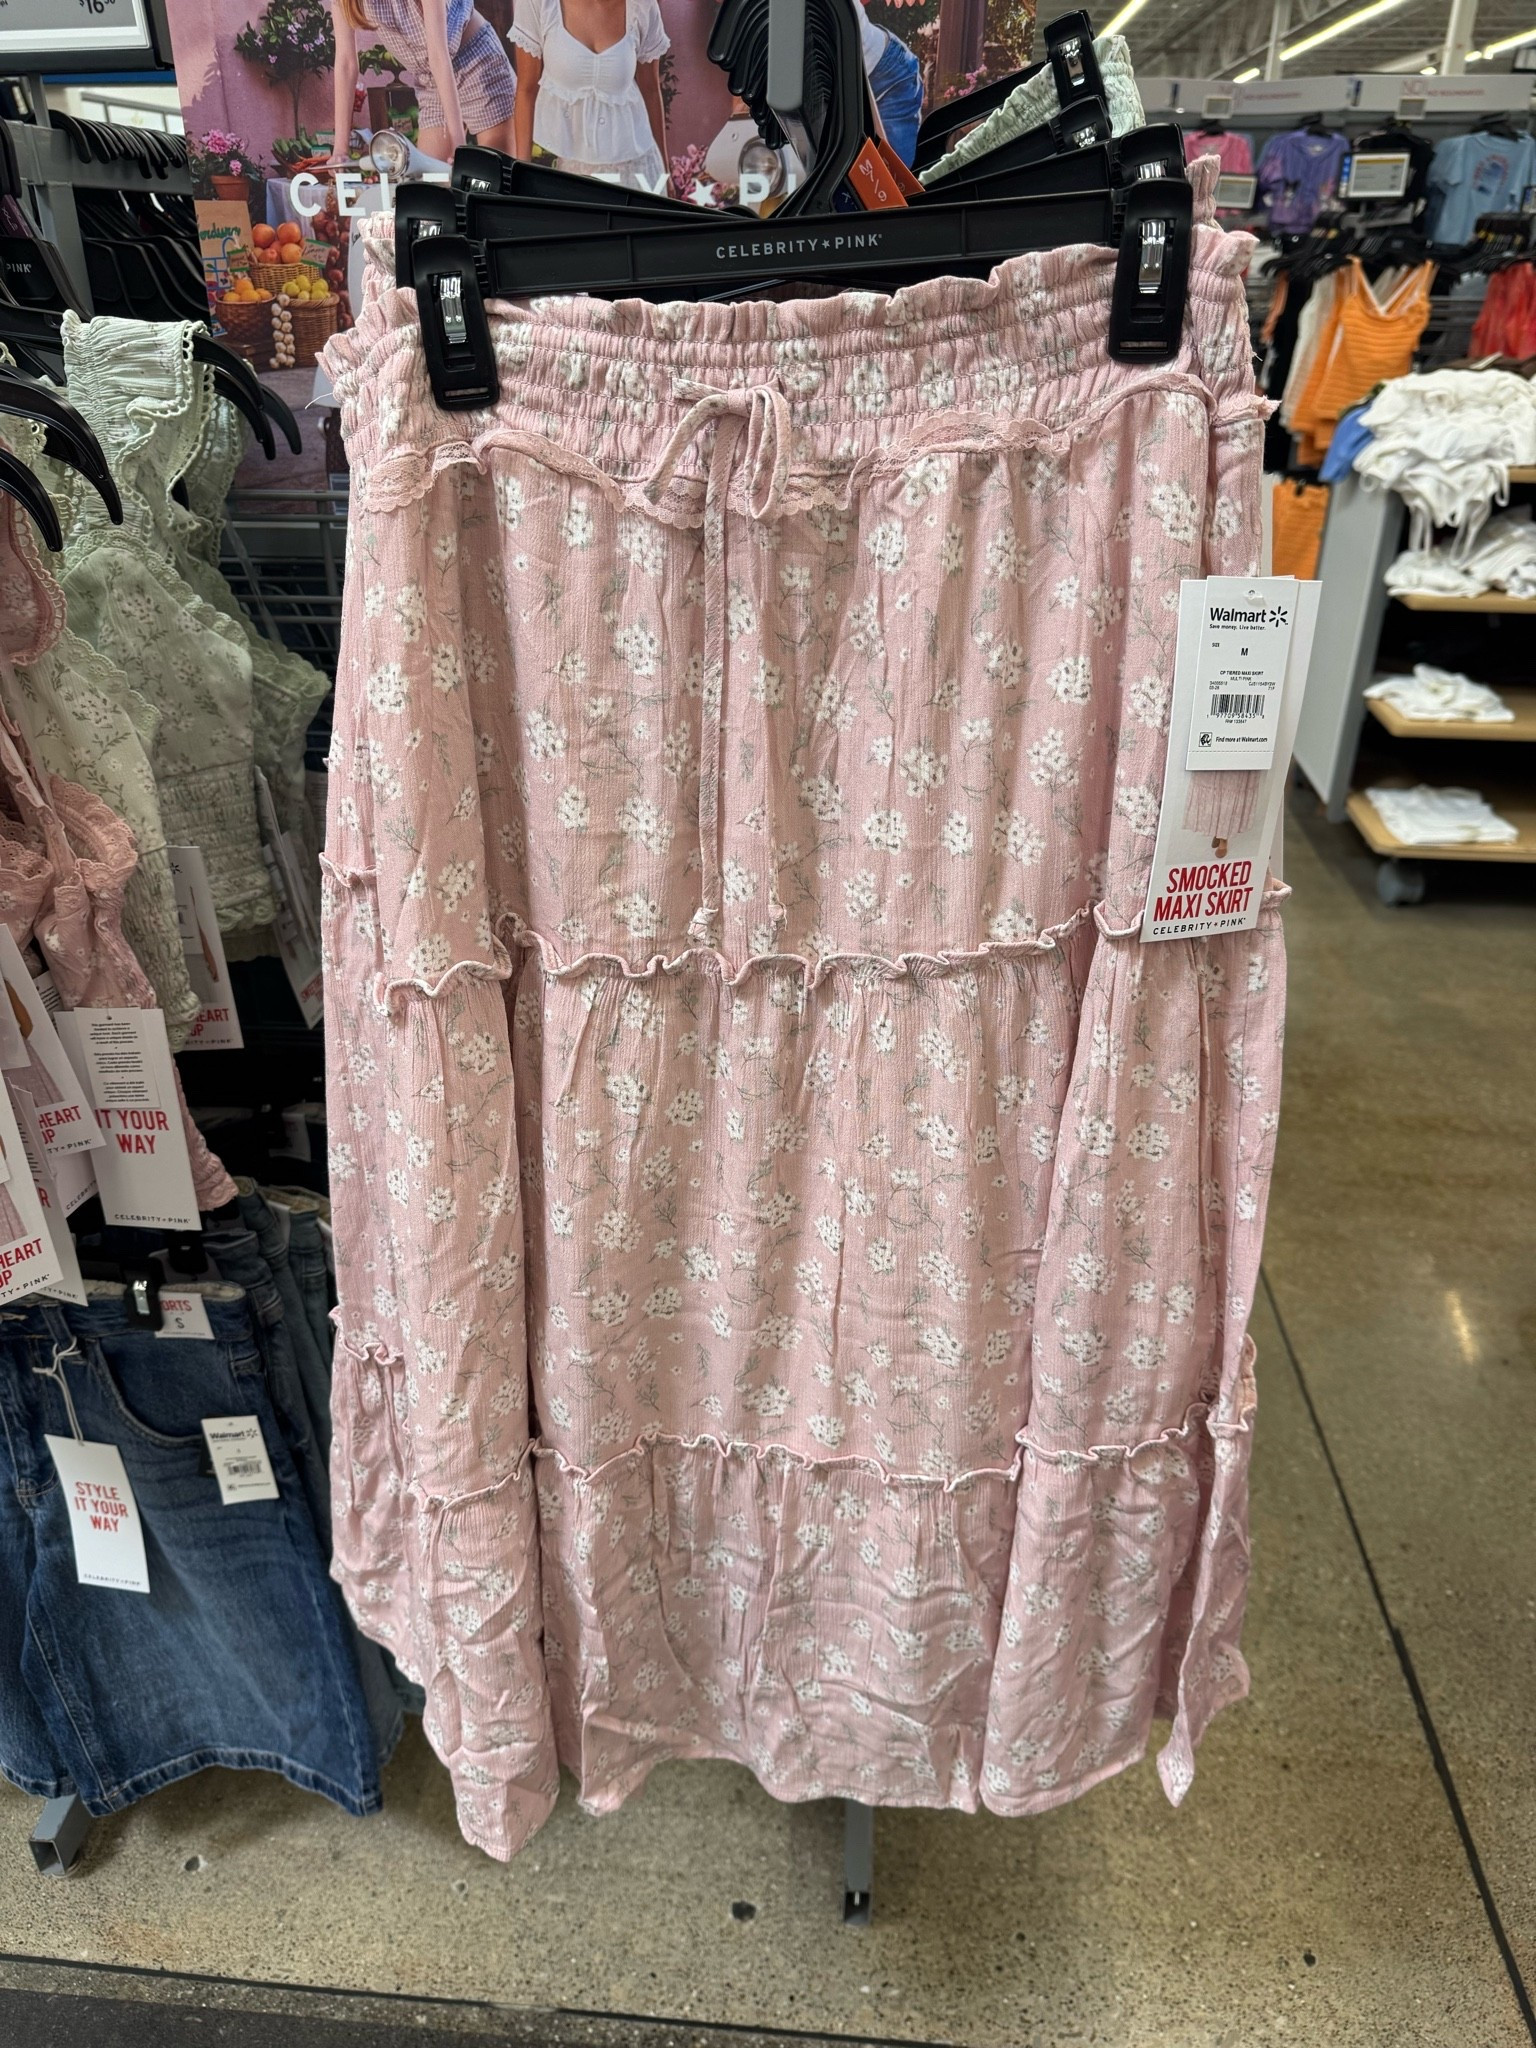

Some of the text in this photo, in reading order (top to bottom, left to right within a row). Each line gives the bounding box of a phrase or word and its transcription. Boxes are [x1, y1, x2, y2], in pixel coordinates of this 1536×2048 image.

[716, 233, 879, 260] CELEBRITY PINK
[1210, 607, 1267, 623] Walmart
[1240, 648, 1249, 656] M
[1166, 860, 1252, 894] SMOCKED
[1153, 887, 1254, 922] MAXI SKIRT
[1153, 918, 1244, 935] CELEBRITY PINK
[95, 1109, 170, 1131] IT YOUR
[115, 1134, 156, 1155] WAY
[114, 1214, 164, 1224] CELEBRITY
[23, 1275, 48, 1290] PINK
[175, 1317, 185, 1329] S
[75, 1481, 120, 1500] STYLE
[74, 1497, 128, 1518] IT YOUR
[90, 1514, 119, 1533] WAY
